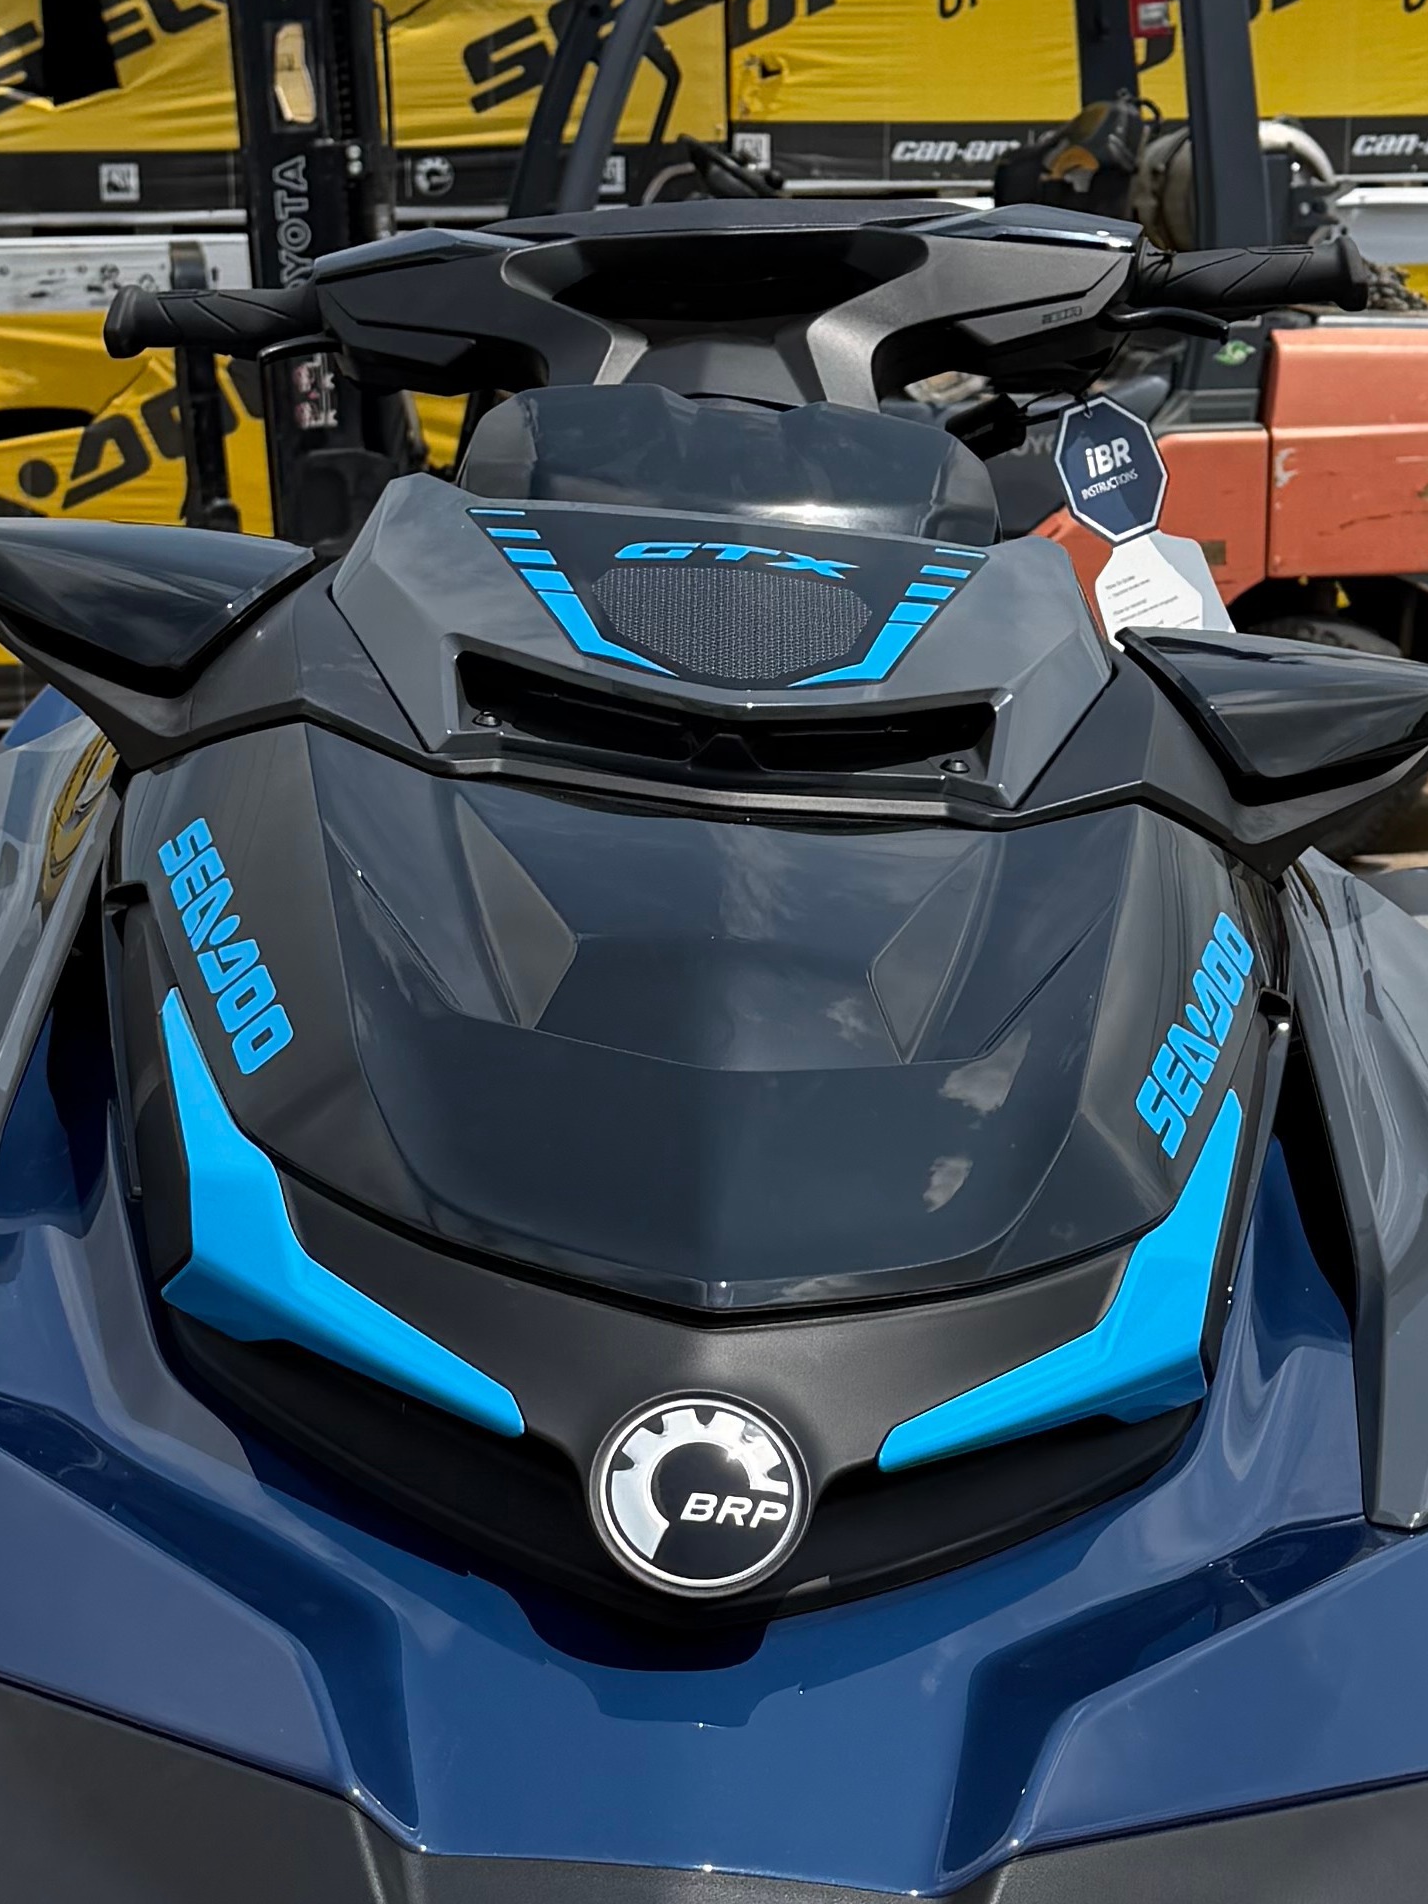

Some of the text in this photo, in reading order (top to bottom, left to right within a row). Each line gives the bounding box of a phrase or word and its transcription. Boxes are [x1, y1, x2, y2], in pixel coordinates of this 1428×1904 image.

[1085, 436, 1132, 479] iBR
[1080, 467, 1139, 501] INSTRUCTIONS
[614, 541, 860, 580] GTX
[679, 1492, 787, 1529] BRP
